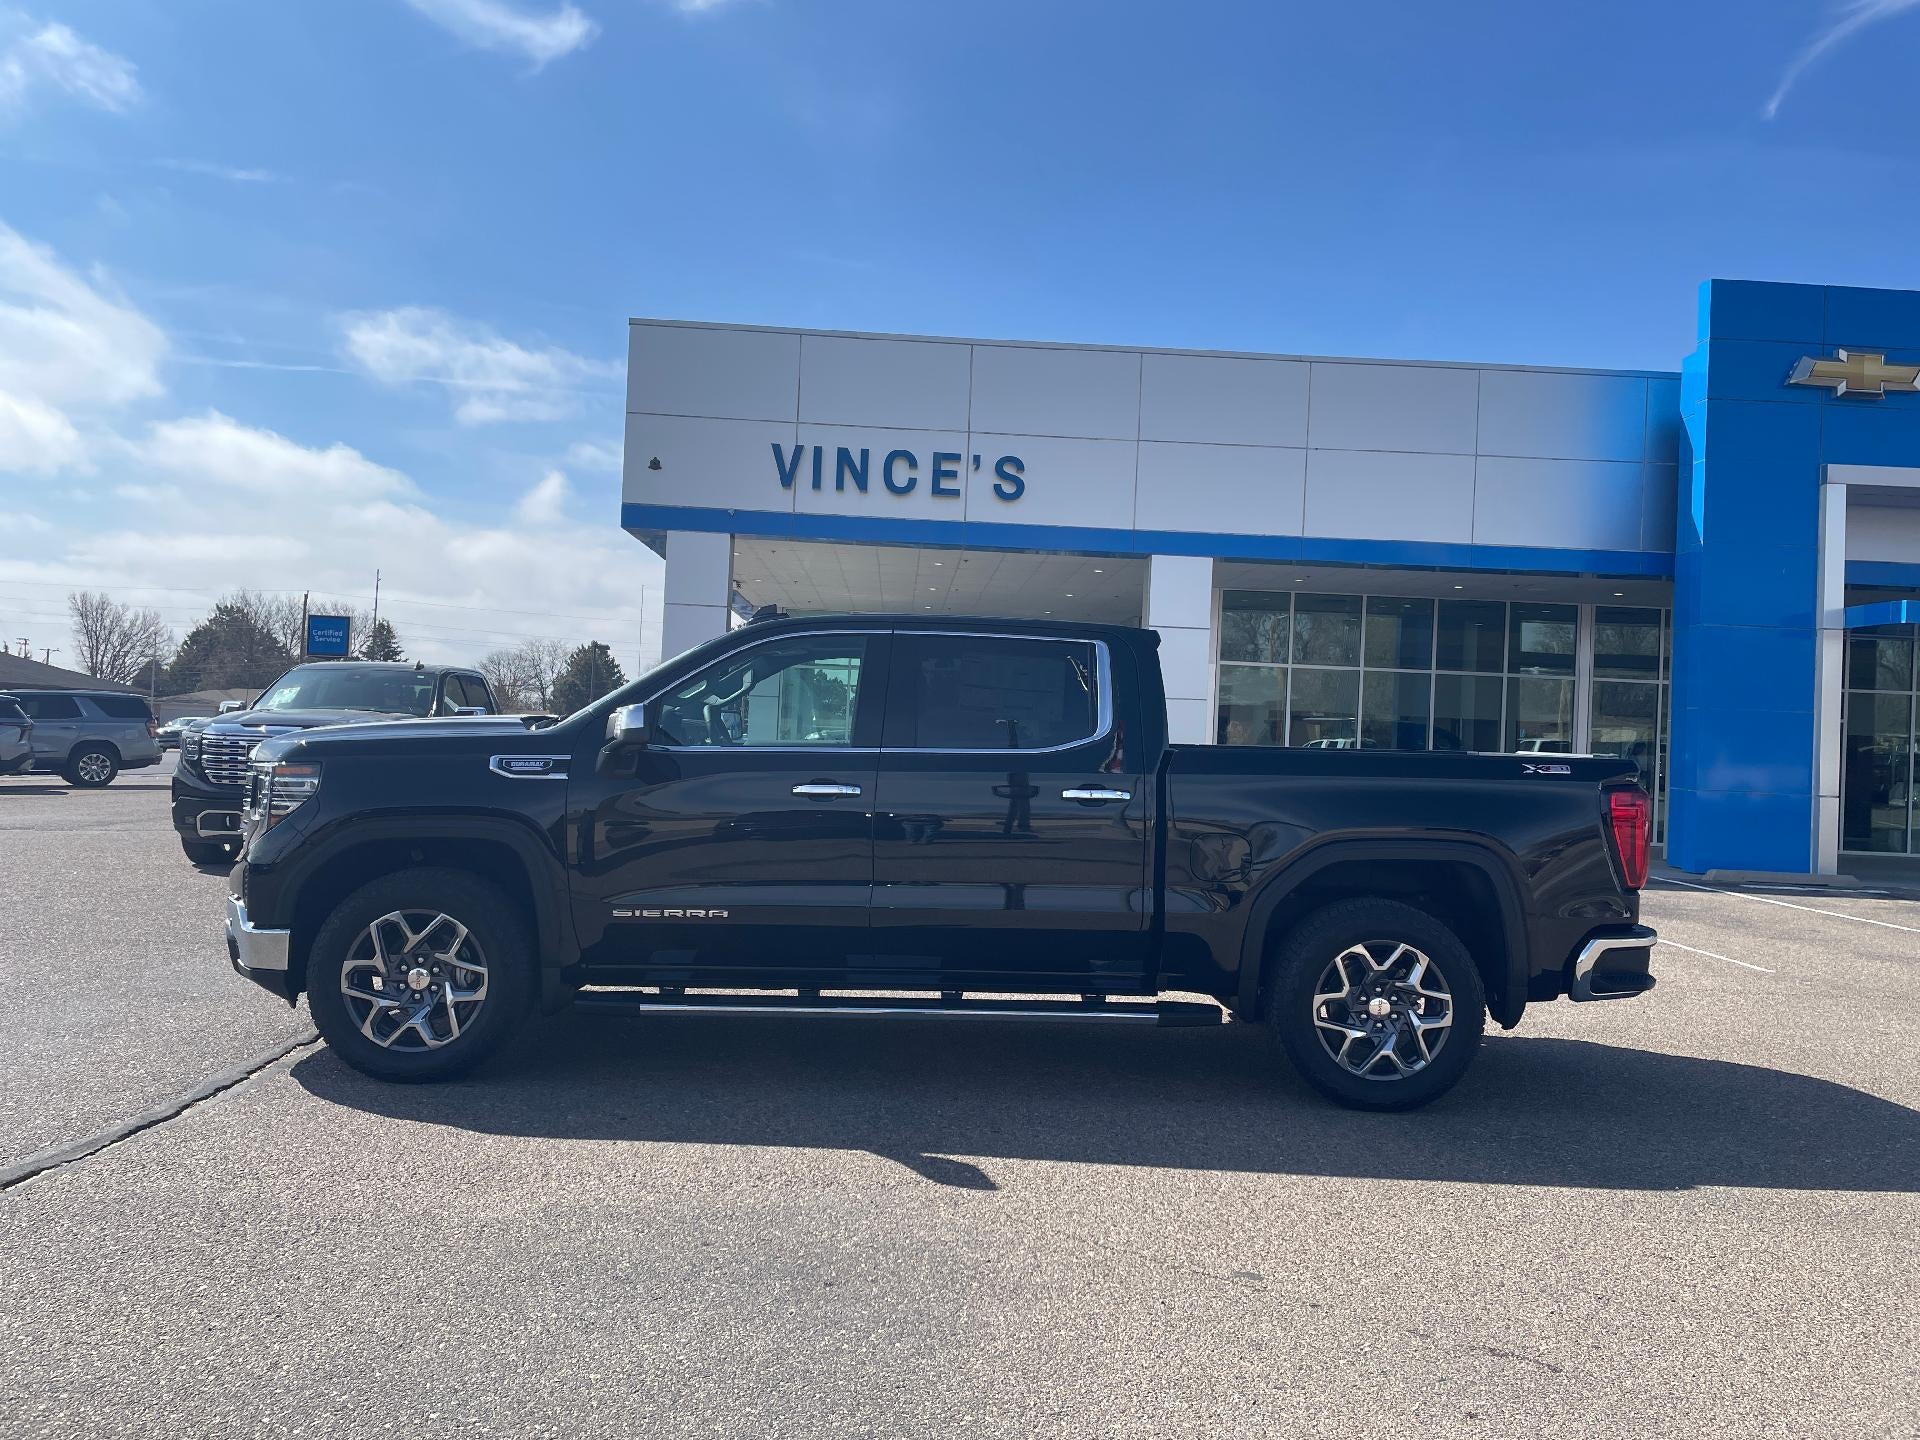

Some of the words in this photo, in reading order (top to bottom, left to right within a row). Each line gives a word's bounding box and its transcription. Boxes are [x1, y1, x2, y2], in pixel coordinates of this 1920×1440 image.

[771, 443, 1026, 501] VINCE'S
[312, 629, 343, 637] Certified
[314, 635, 341, 643] Service
[612, 909, 729, 918] SIERRA
